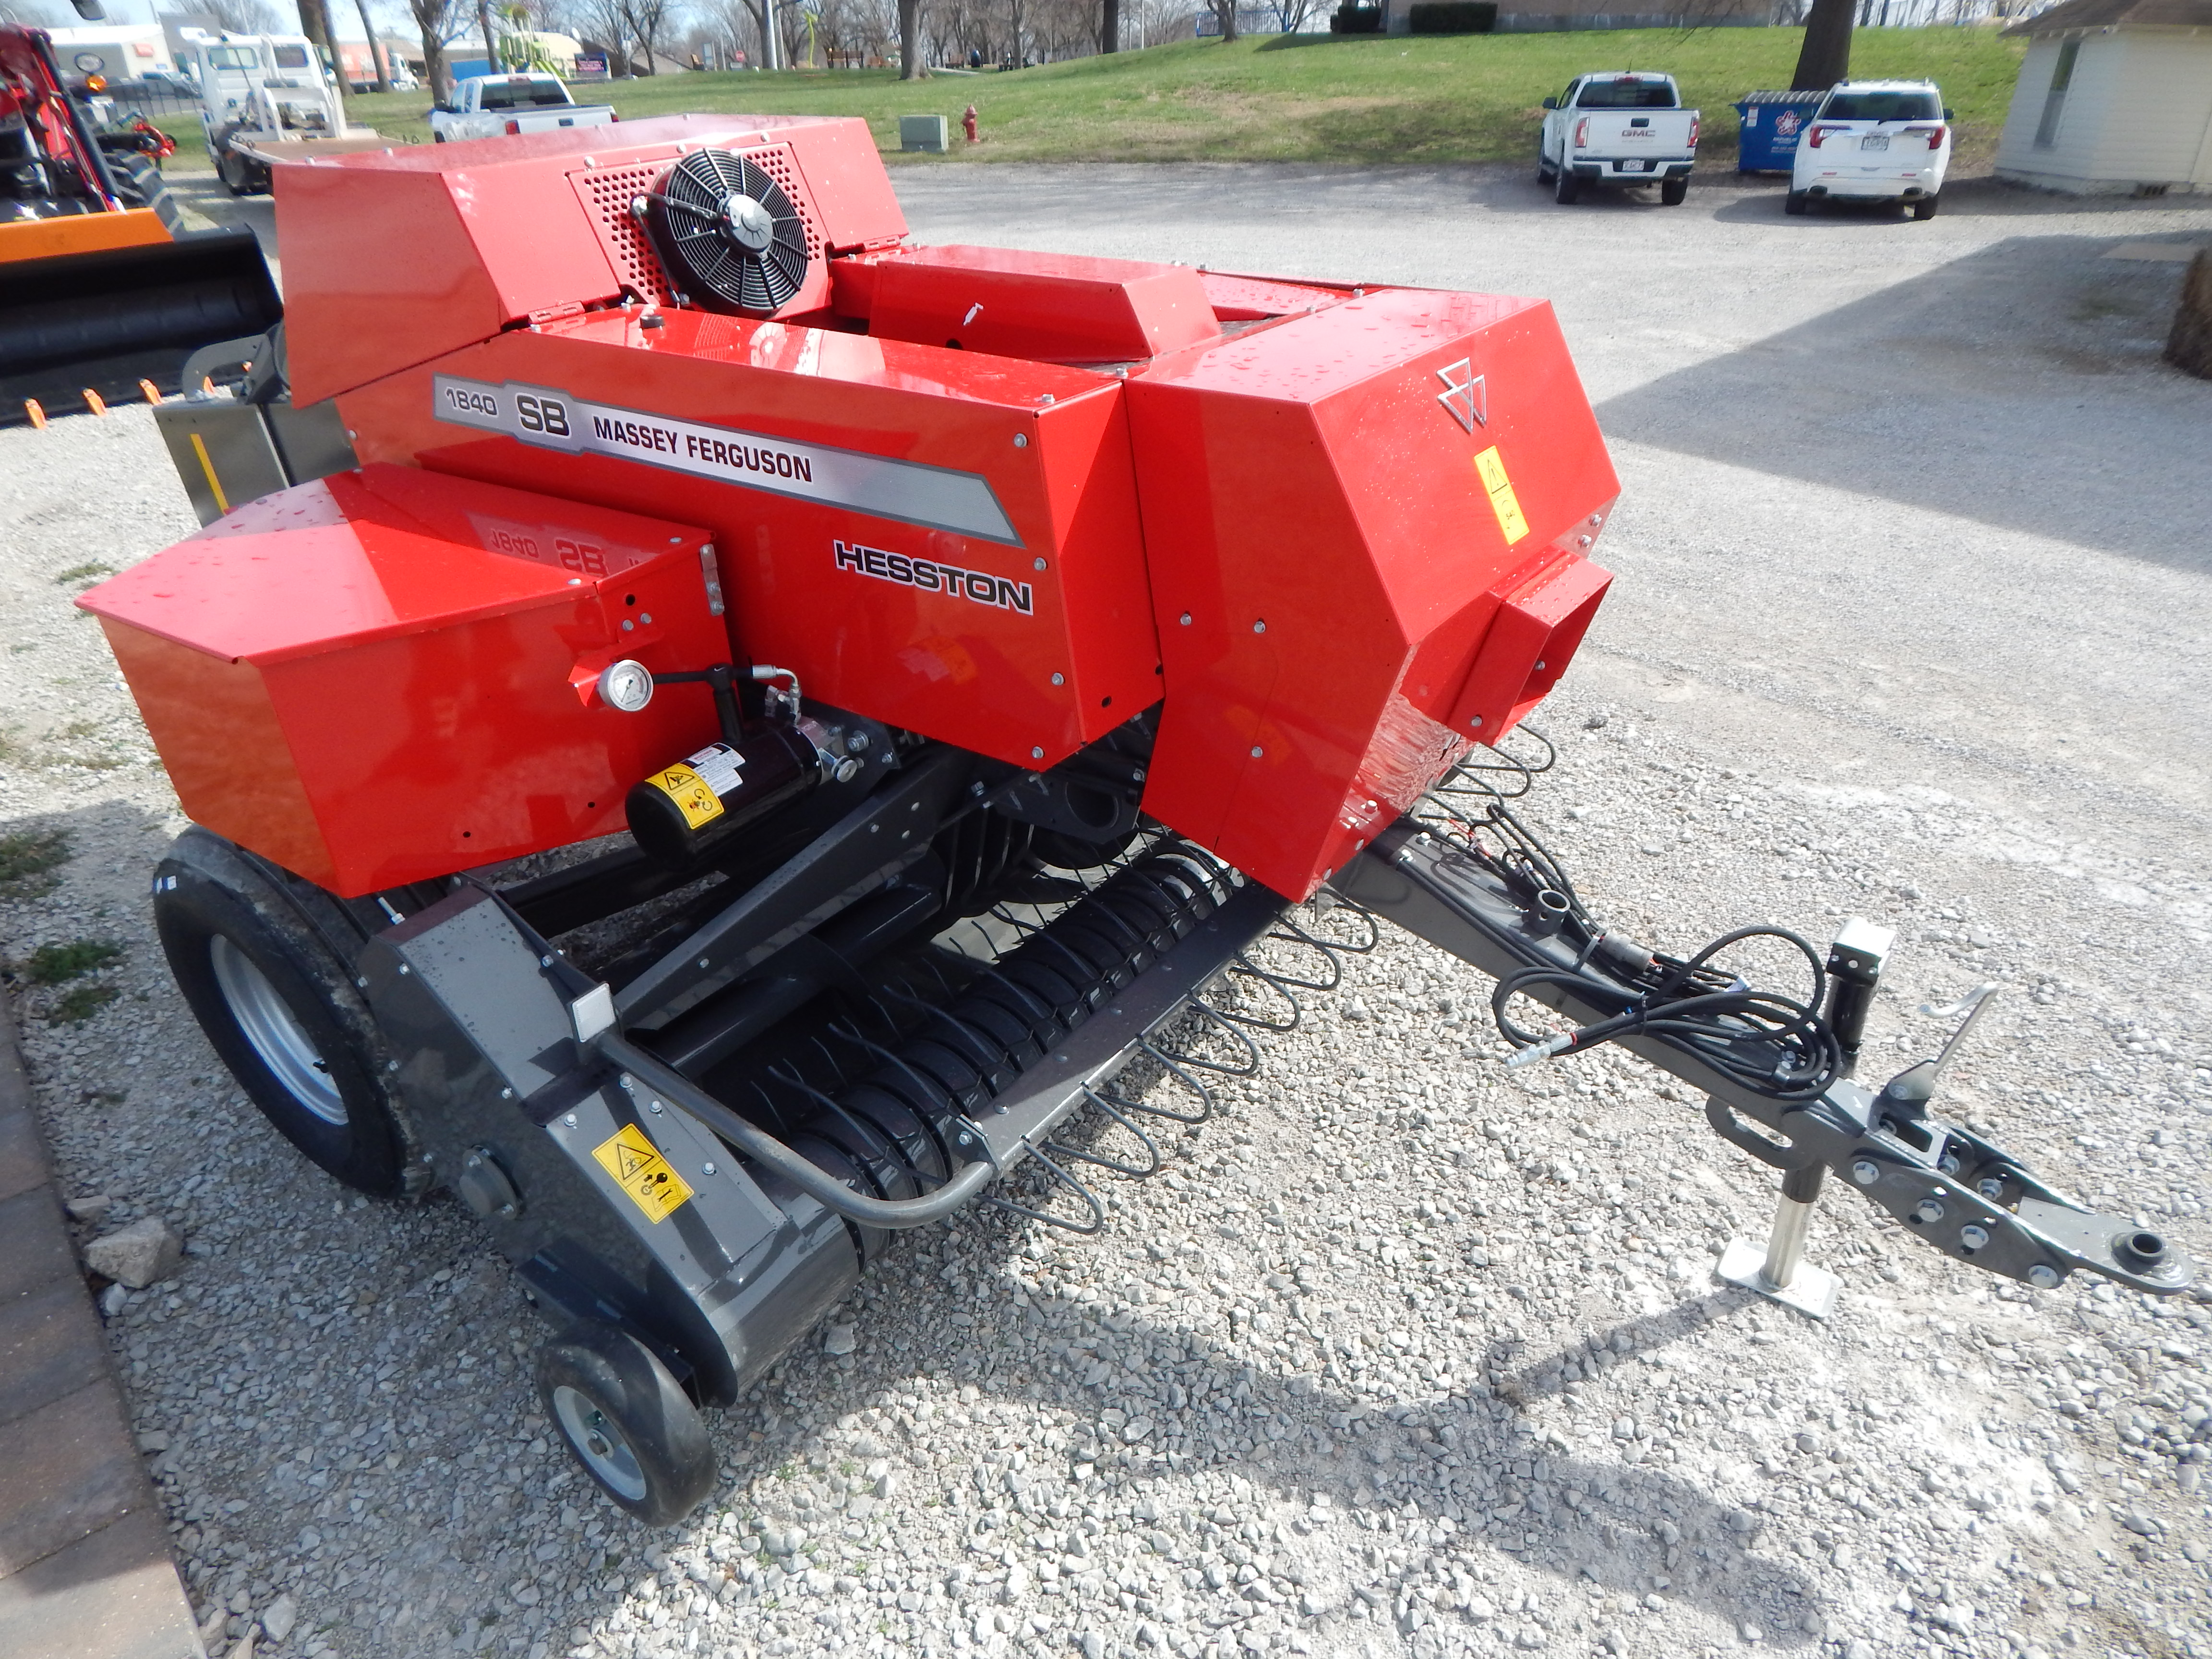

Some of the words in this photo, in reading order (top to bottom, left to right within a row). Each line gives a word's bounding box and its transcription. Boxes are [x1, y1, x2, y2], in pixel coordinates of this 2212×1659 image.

[445, 387, 498, 417] 1840
[515, 392, 572, 439] SB
[592, 415, 678, 454] MASSEY
[686, 433, 813, 483] FERGUSON
[834, 540, 1033, 615] HESSTON
